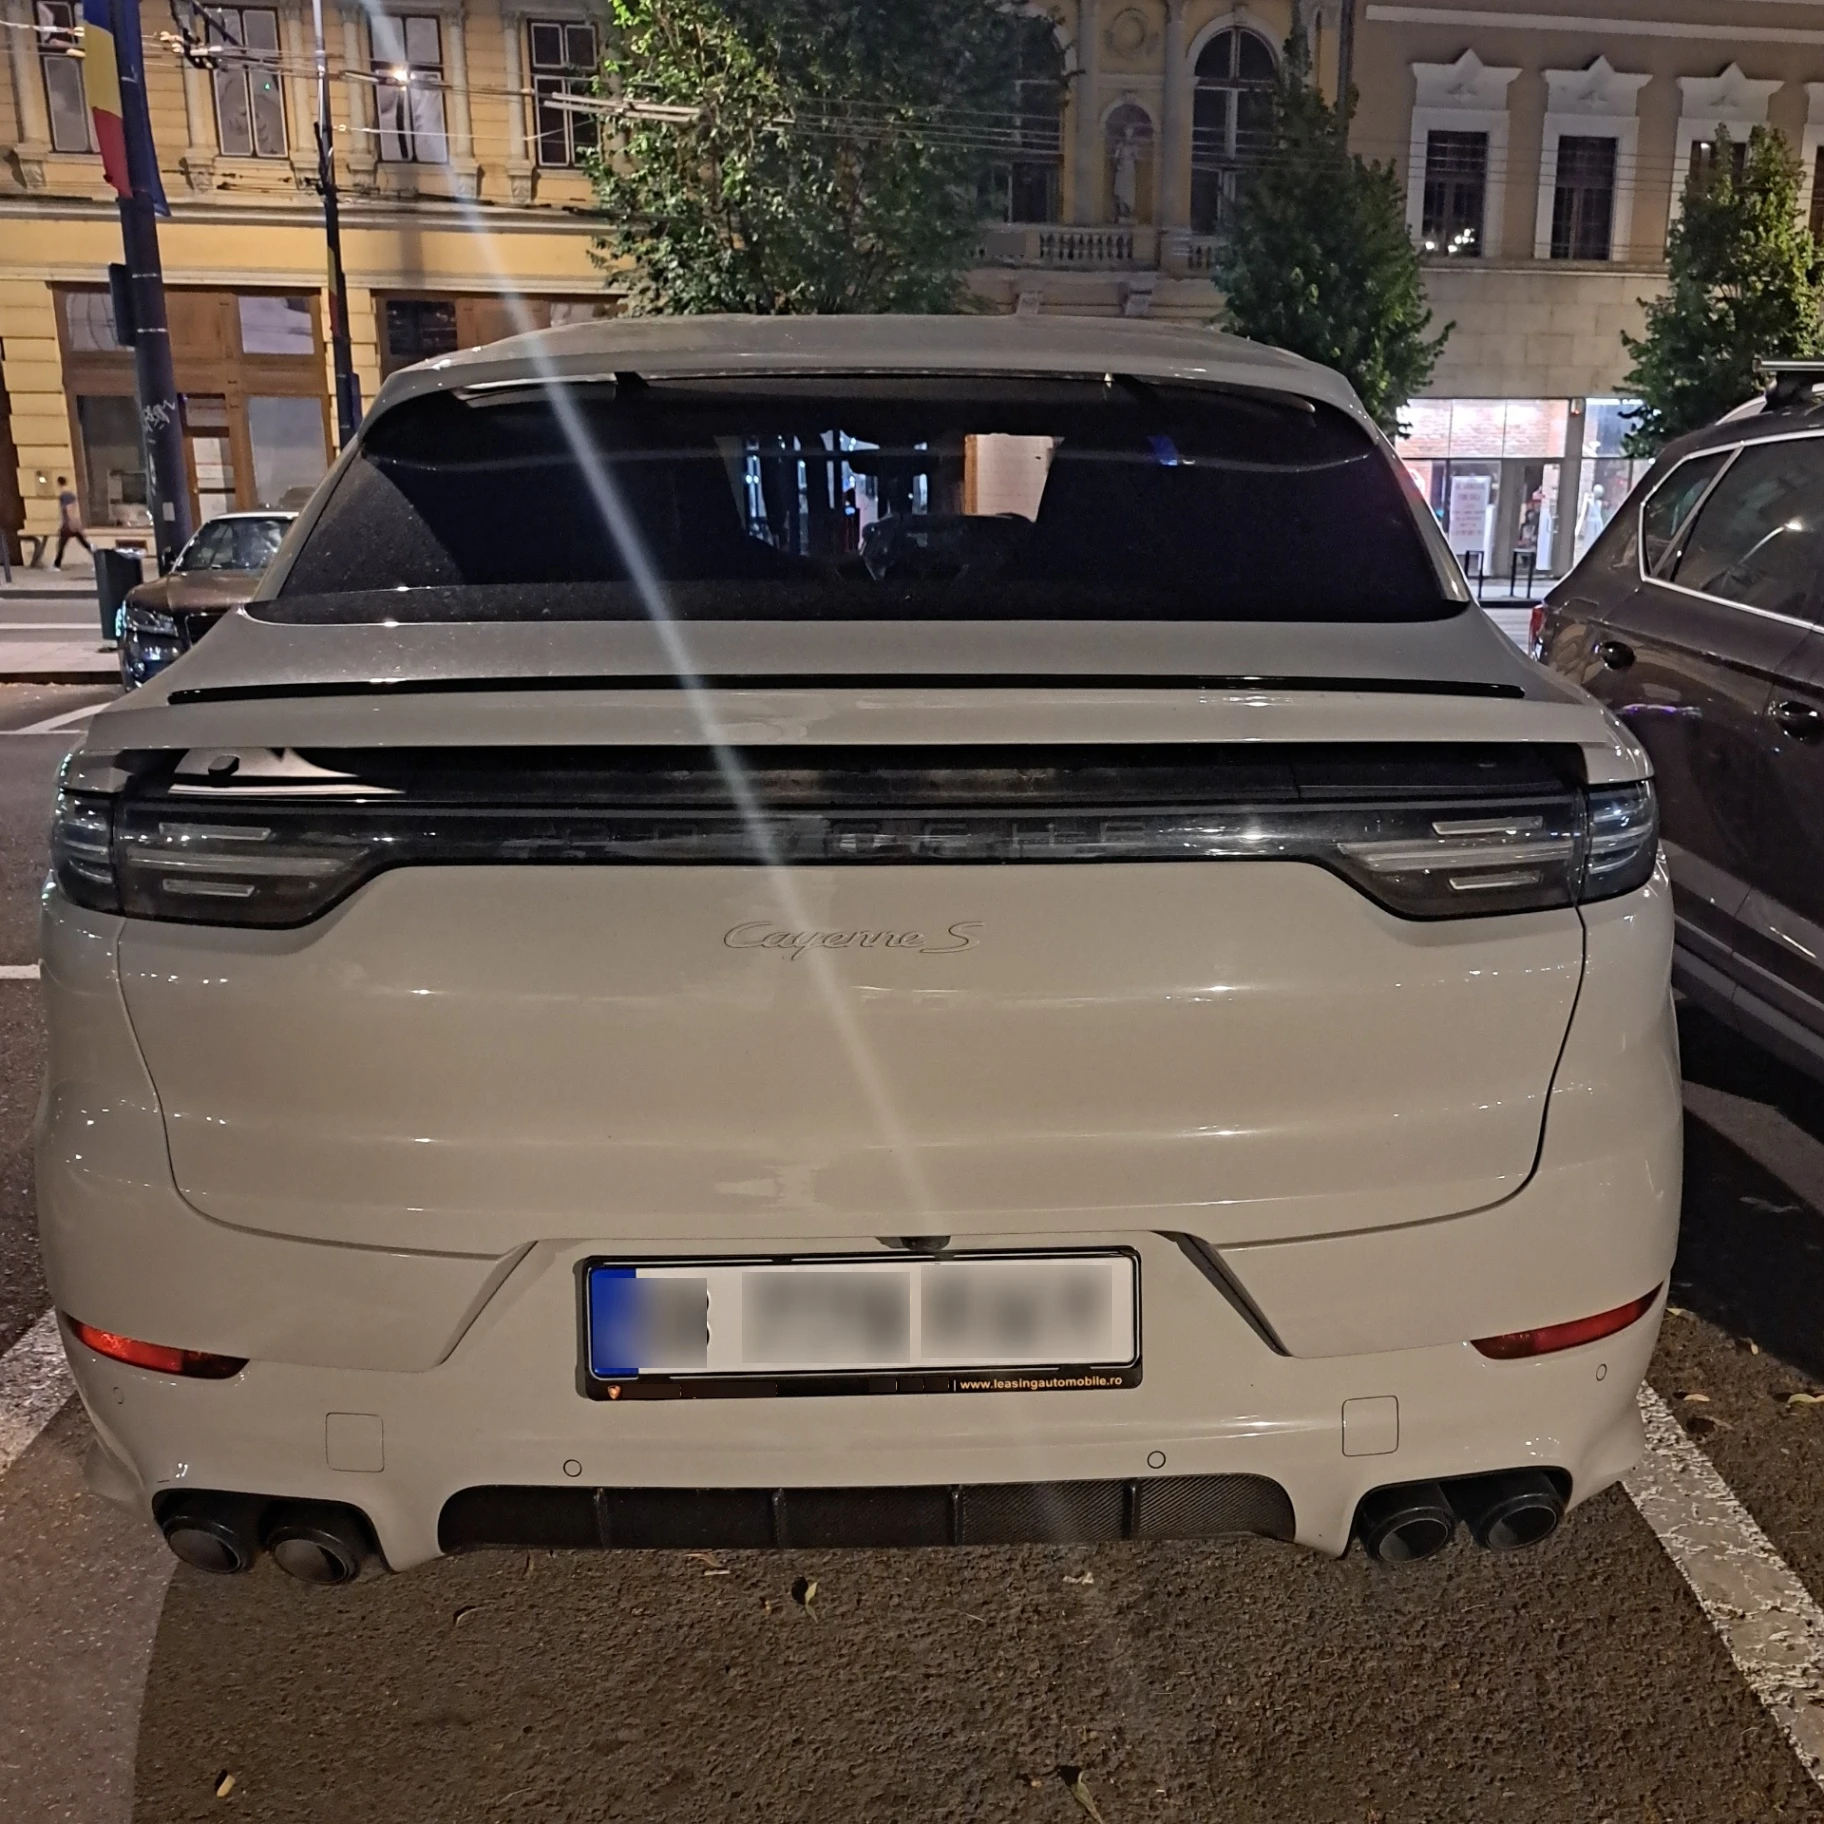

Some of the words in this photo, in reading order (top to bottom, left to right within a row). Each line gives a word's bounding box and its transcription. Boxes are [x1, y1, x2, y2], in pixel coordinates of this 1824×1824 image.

[723, 920, 925, 961] Cayenne
[919, 920, 986, 954] S
[960, 1375, 1123, 1391] www.leasingautomobile.ro
